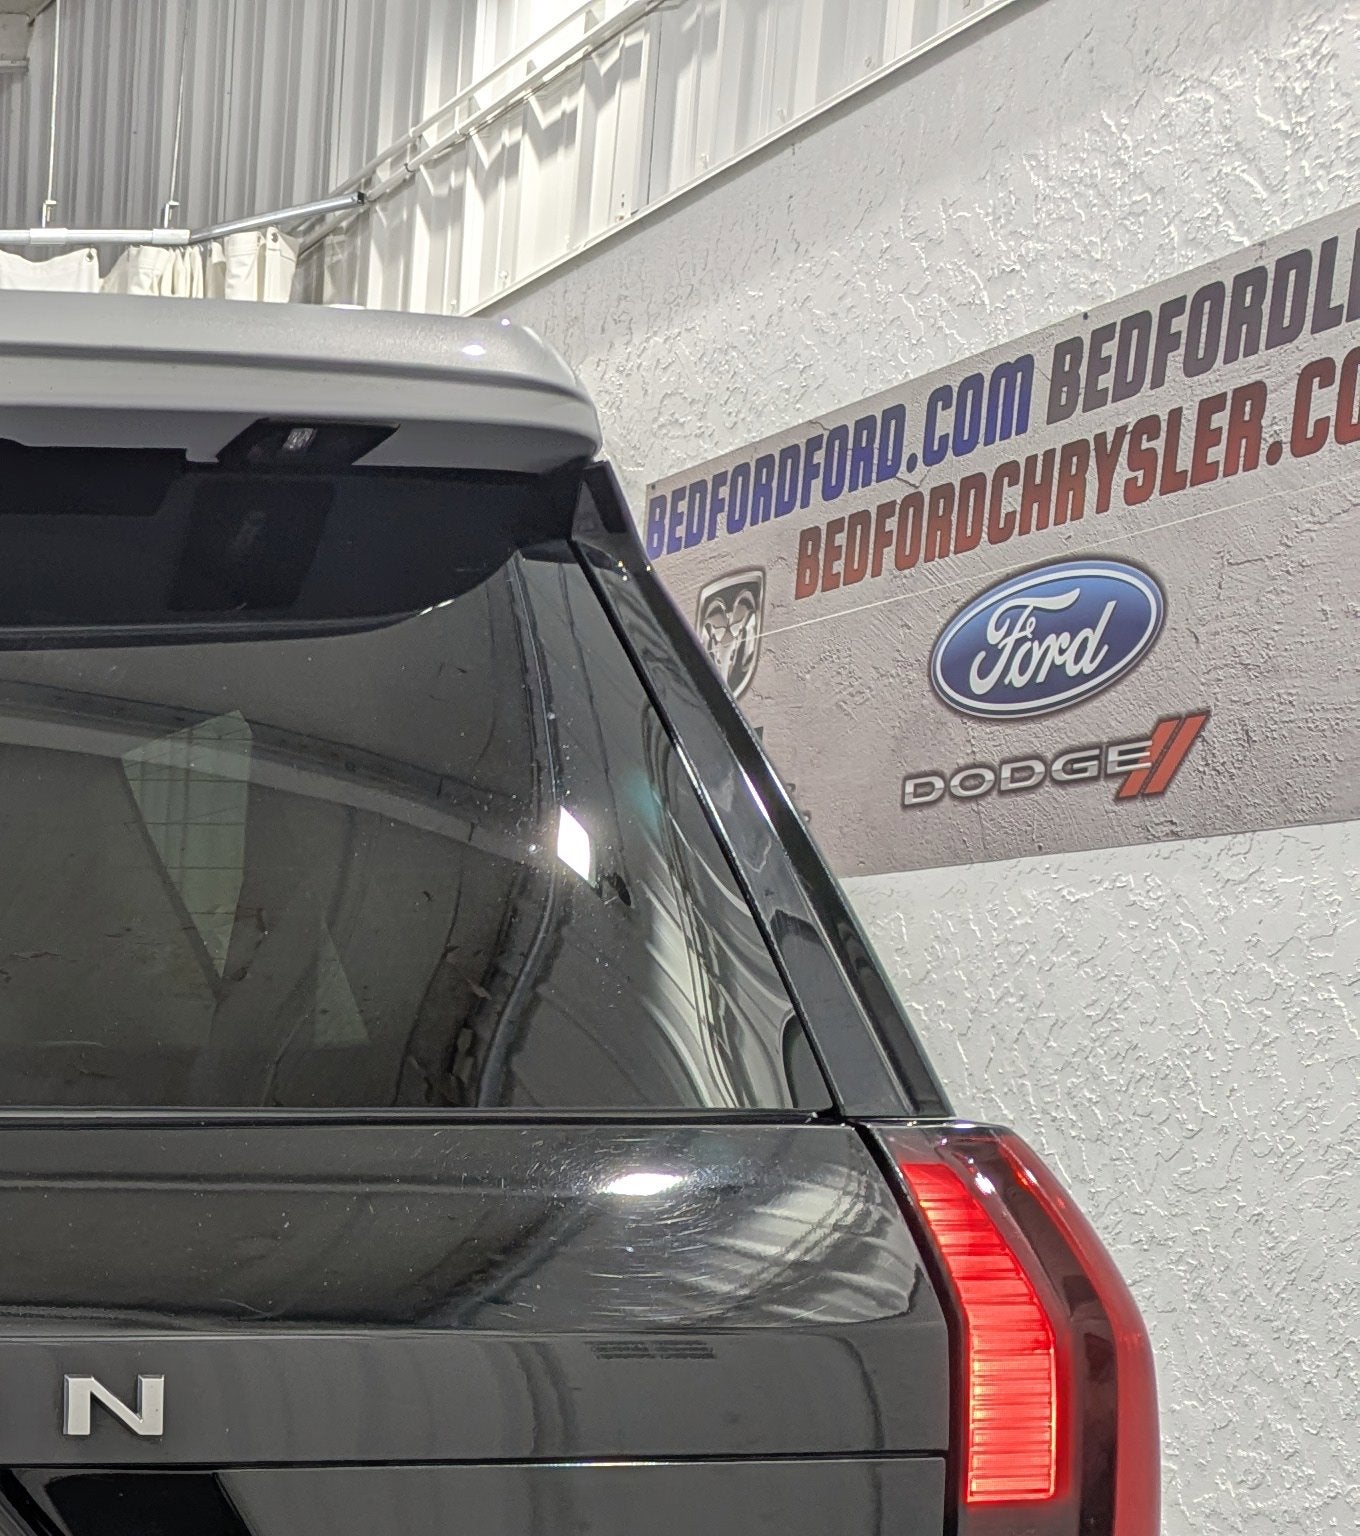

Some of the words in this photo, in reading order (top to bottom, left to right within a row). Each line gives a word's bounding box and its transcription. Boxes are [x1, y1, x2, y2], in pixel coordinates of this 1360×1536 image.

[646, 353, 1035, 561] BEDFORDFORD.COM
[969, 588, 1117, 695] Ford
[904, 740, 1153, 806] DODGE
